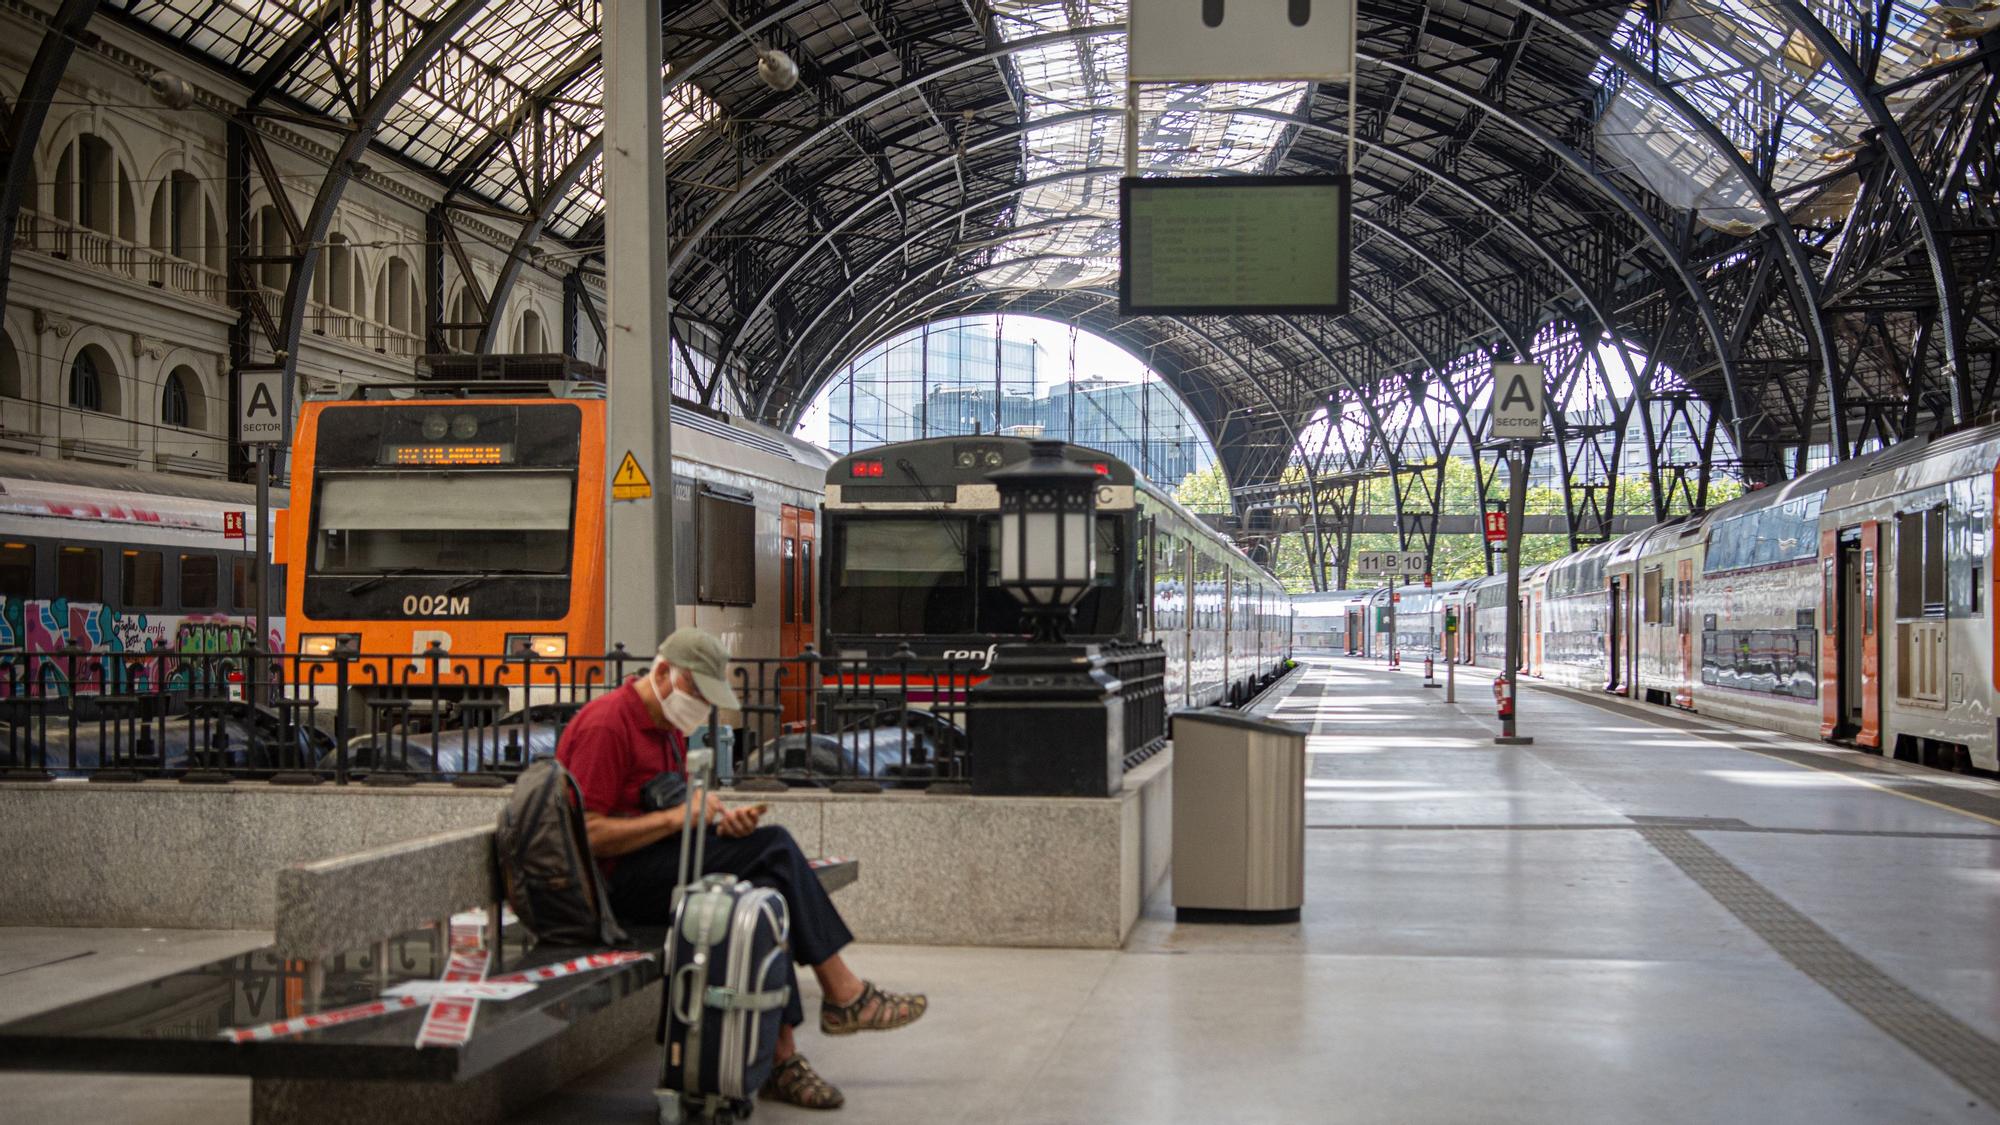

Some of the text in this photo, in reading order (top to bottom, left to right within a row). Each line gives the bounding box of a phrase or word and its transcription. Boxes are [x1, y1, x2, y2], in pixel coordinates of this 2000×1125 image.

[247, 382, 277, 417] A
[1501, 374, 1535, 412] A
[243, 423, 281, 432] SECTOR
[1496, 418, 1539, 427] SECTOR
[1362, 555, 1422, 570] 11 B 10
[402, 595, 470, 615] 002M
[412, 630, 452, 674] R
